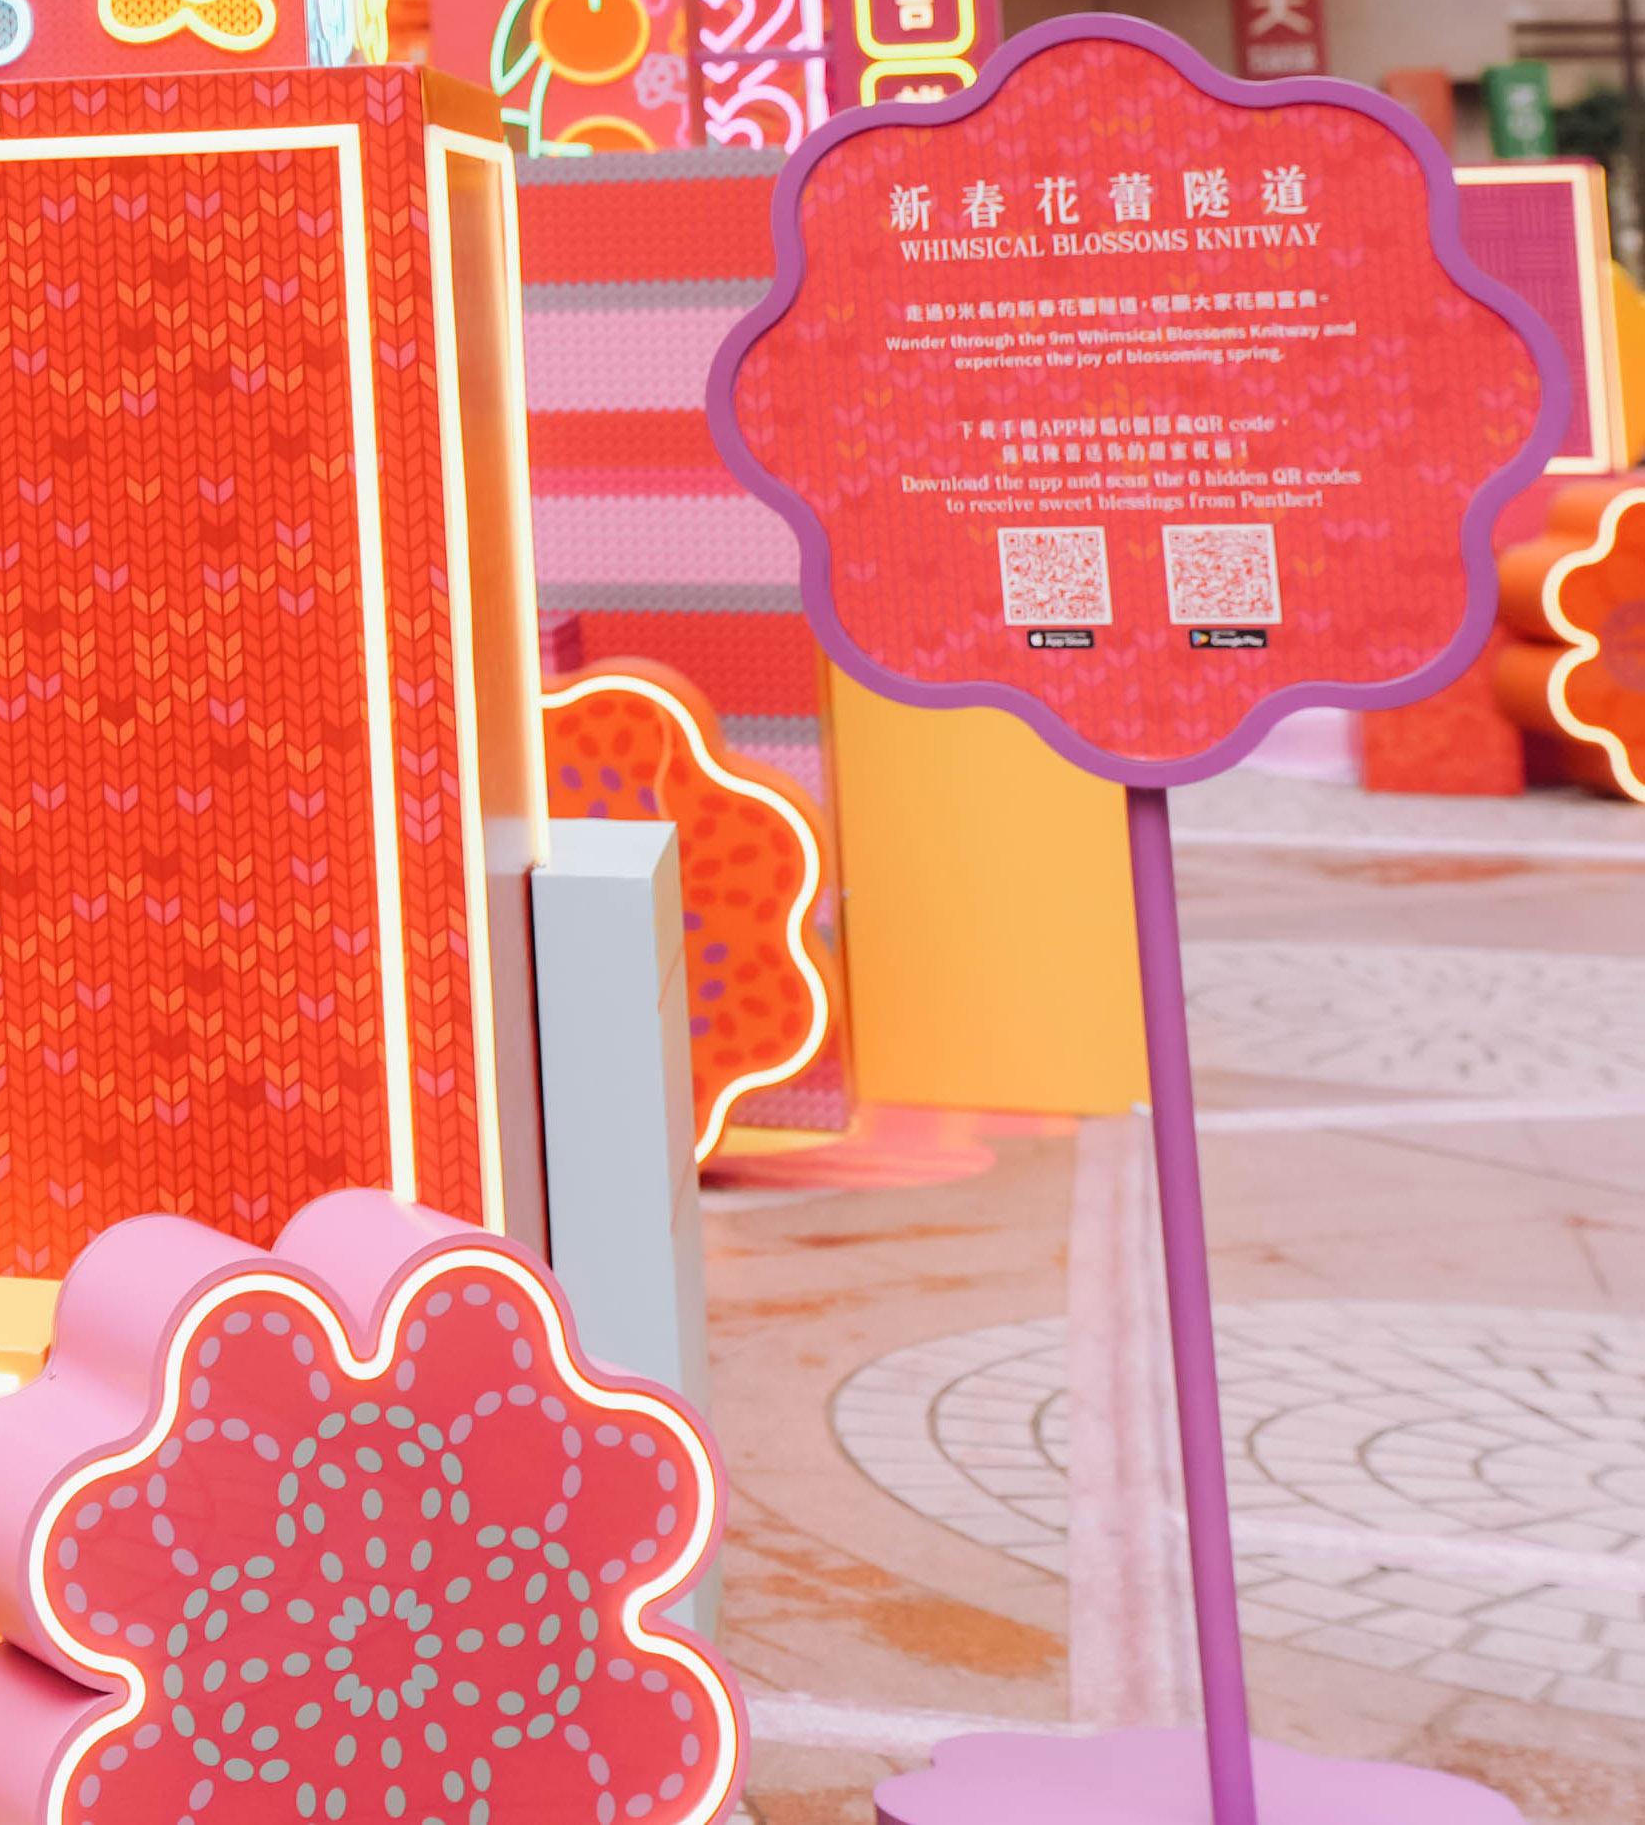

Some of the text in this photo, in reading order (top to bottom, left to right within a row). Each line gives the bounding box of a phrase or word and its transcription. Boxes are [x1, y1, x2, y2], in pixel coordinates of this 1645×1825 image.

[889, 164, 1310, 233] 新春花蕾隧道
[900, 222, 1322, 263] WHIMSICAL BLOSSOMS KNITWAY
[886, 321, 1357, 351] Wander through the 9m Whimsical Blossoms Knitway and
[955, 352, 1043, 372] experience
[1047, 349, 1074, 367] the
[1077, 349, 1103, 369] joy
[1106, 348, 1124, 365] of
[1126, 347, 1224, 366] blossoming
[902, 466, 1361, 493] Download the app and scan the 6 hidden QR codes
[946, 489, 1324, 514] to receive sweet blessings from Panther!
